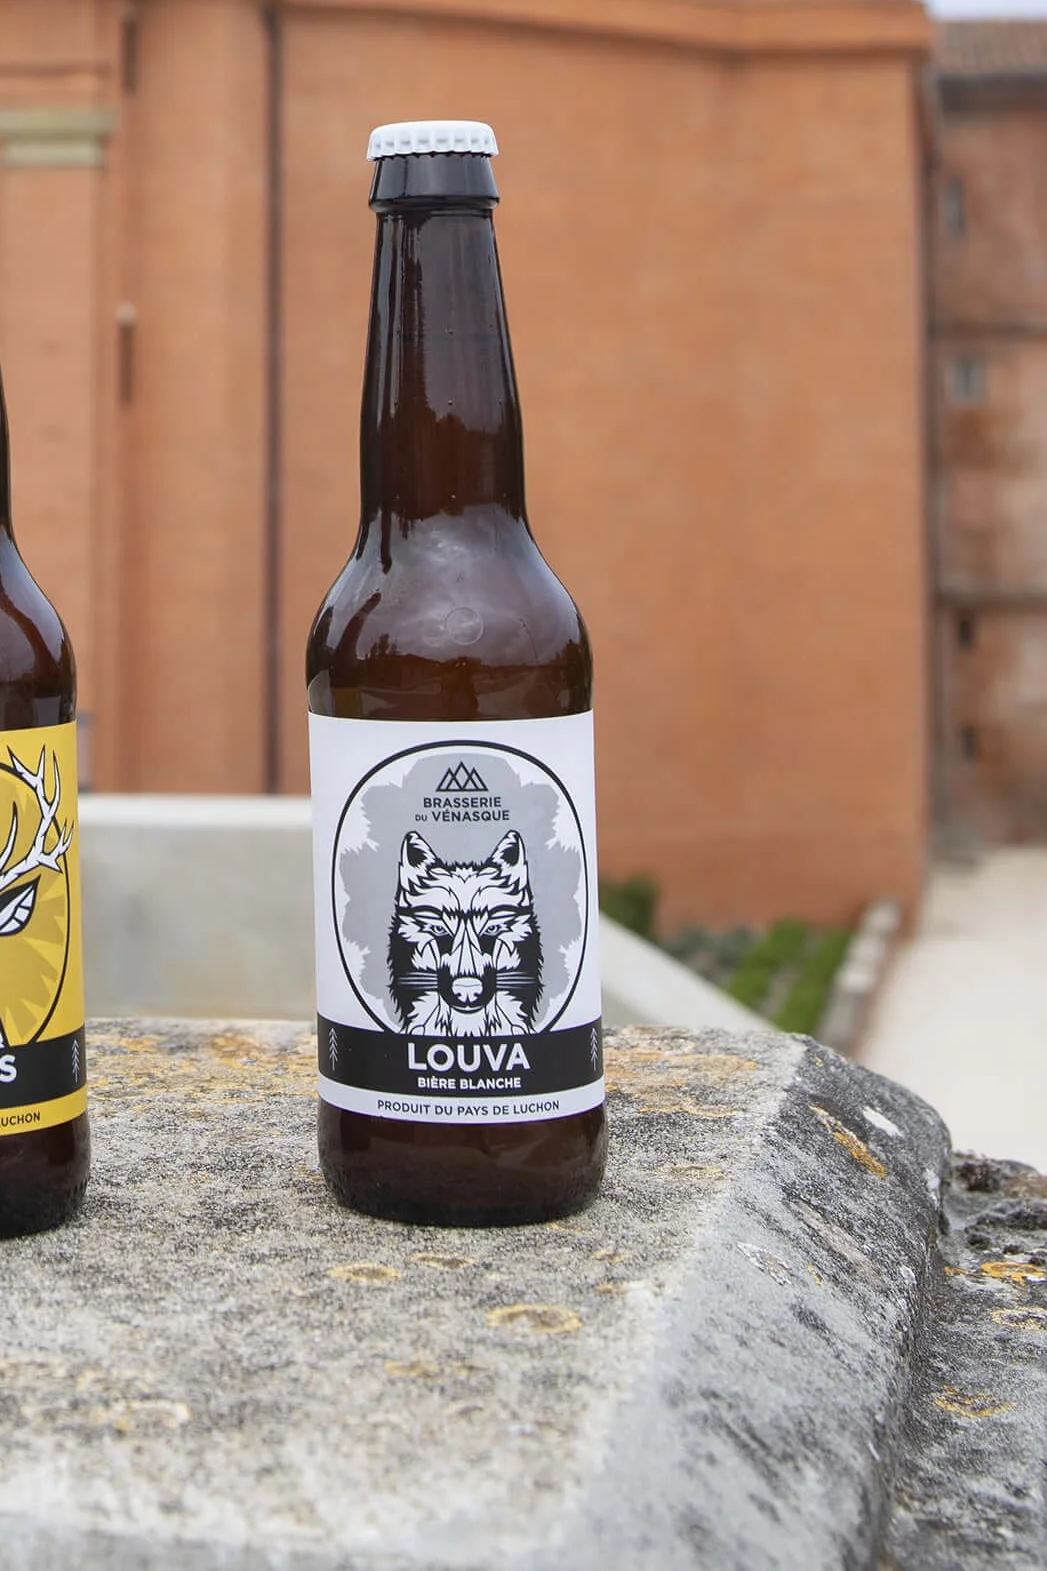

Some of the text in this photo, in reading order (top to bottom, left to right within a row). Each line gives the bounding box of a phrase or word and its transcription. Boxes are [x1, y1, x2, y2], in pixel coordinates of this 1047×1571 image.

[423, 797, 502, 808] BRASSERIE
[432, 809, 510, 822] VÉNASQUE
[408, 1042, 531, 1072] LOUVA
[417, 1076, 522, 1090] BIÈRE BLANCHE
[377, 1100, 560, 1116] PRODUIT DU PAYS DE LUCHON
